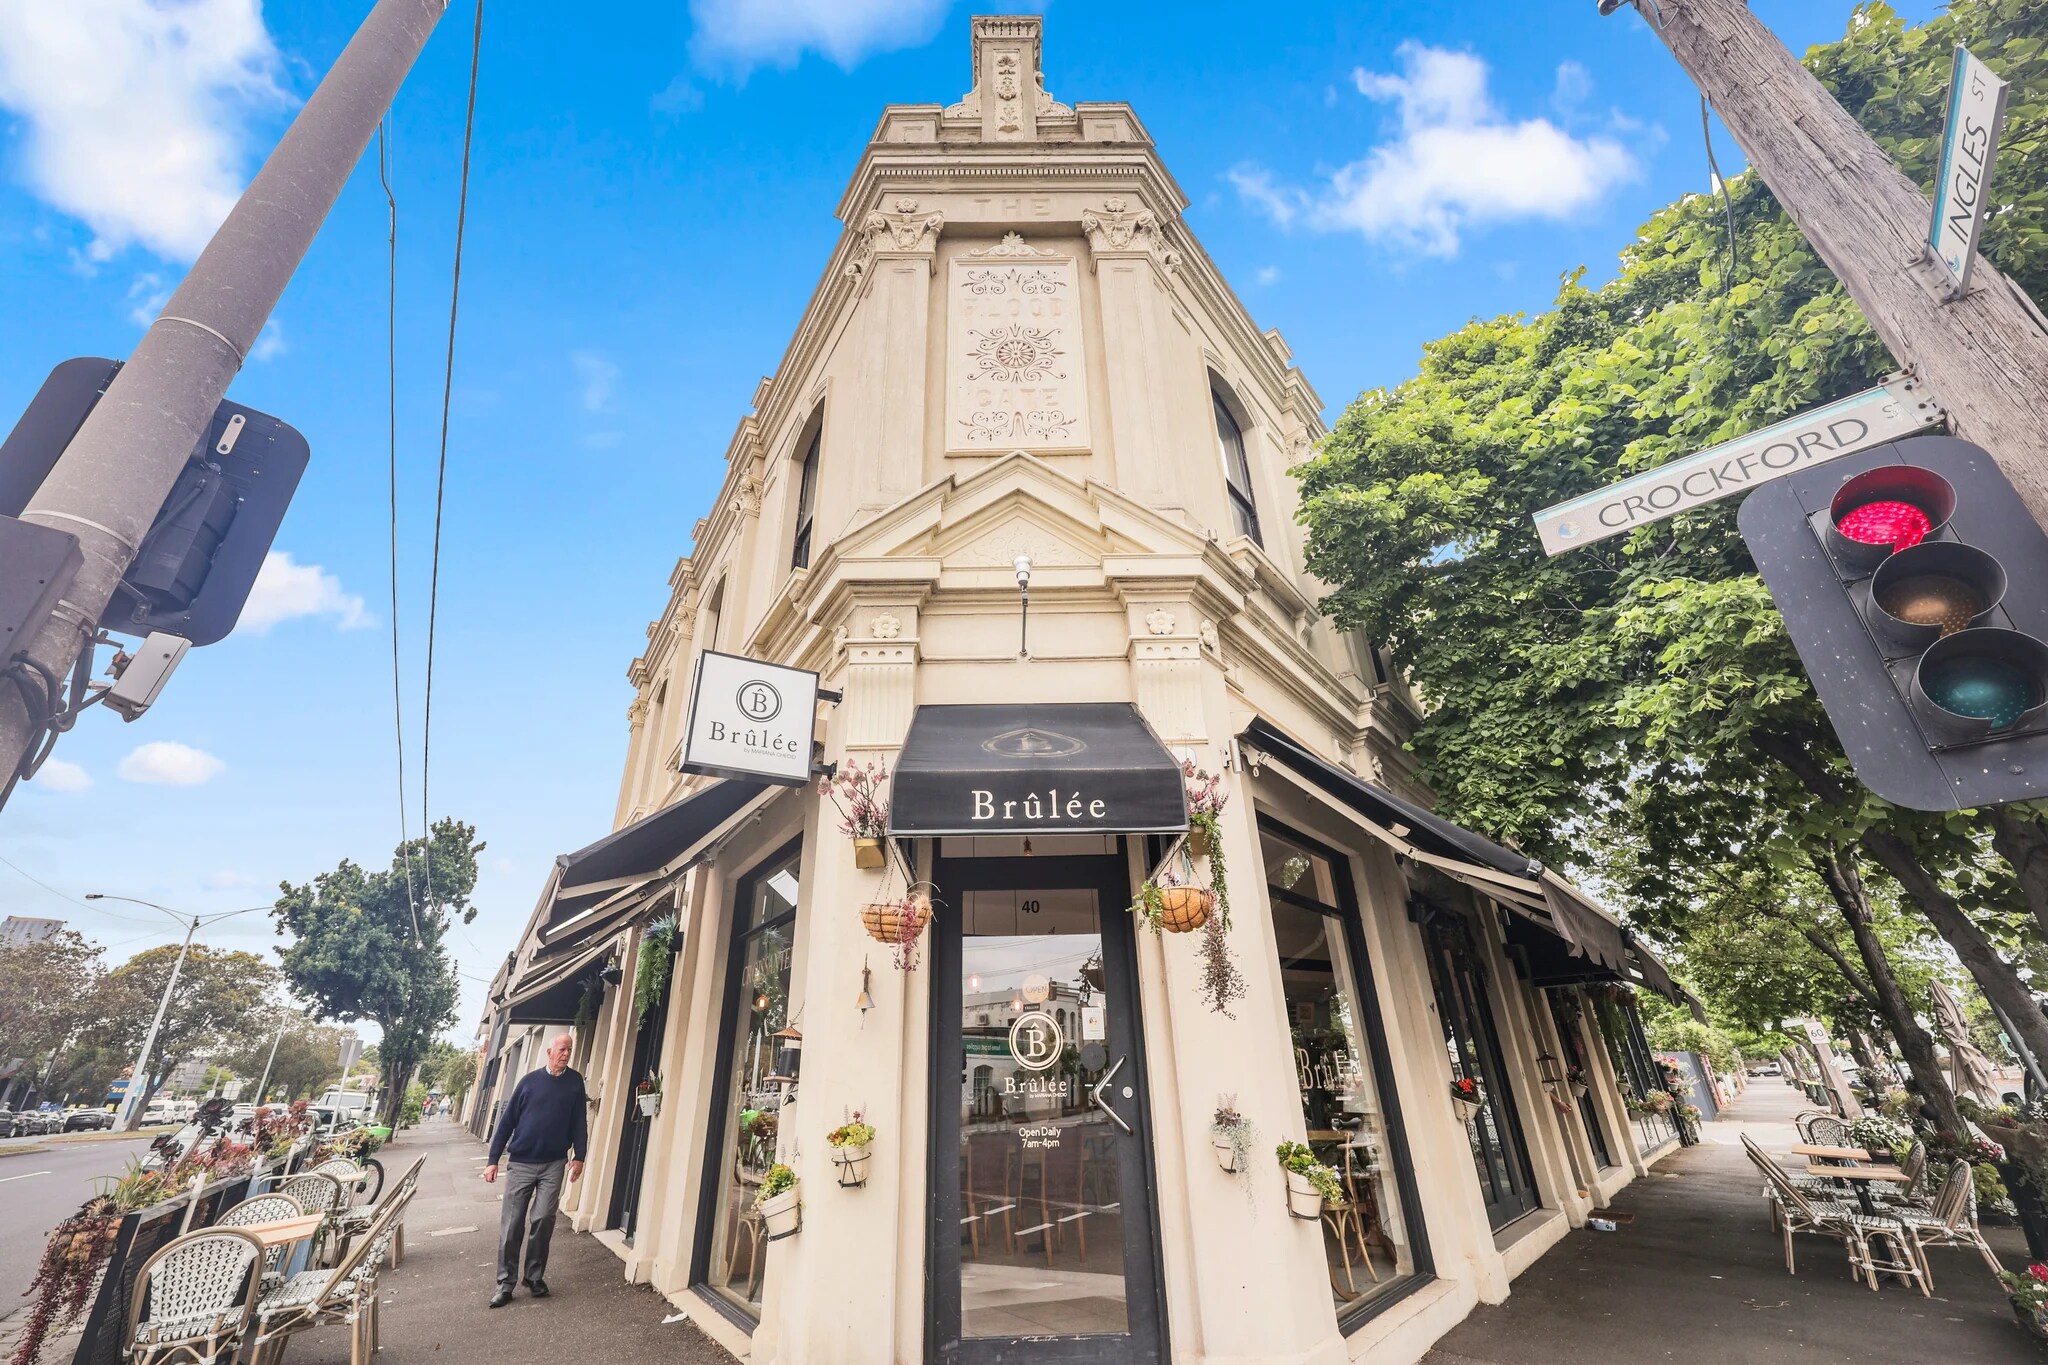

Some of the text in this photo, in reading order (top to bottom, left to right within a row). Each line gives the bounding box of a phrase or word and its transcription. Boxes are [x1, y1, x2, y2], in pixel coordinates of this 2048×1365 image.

[1948, 70, 1987, 245] INGLES ST
[974, 198, 1050, 216] THE
[962, 298, 1063, 318] FLOOD
[975, 388, 1059, 408] GATE
[1598, 418, 1869, 528] CROCKFORD
[709, 721, 798, 753] Brûlée
[971, 789, 1106, 820] Brûlée
[1022, 900, 1040, 914] 40
[1026, 985, 1048, 993] OPEN
[1810, 1028, 1824, 1038] 60
[1004, 1077, 1068, 1094] Brûlée
[1019, 1127, 1062, 1139] Open Daily
[1021, 1138, 1060, 1149] 7am-4pm
